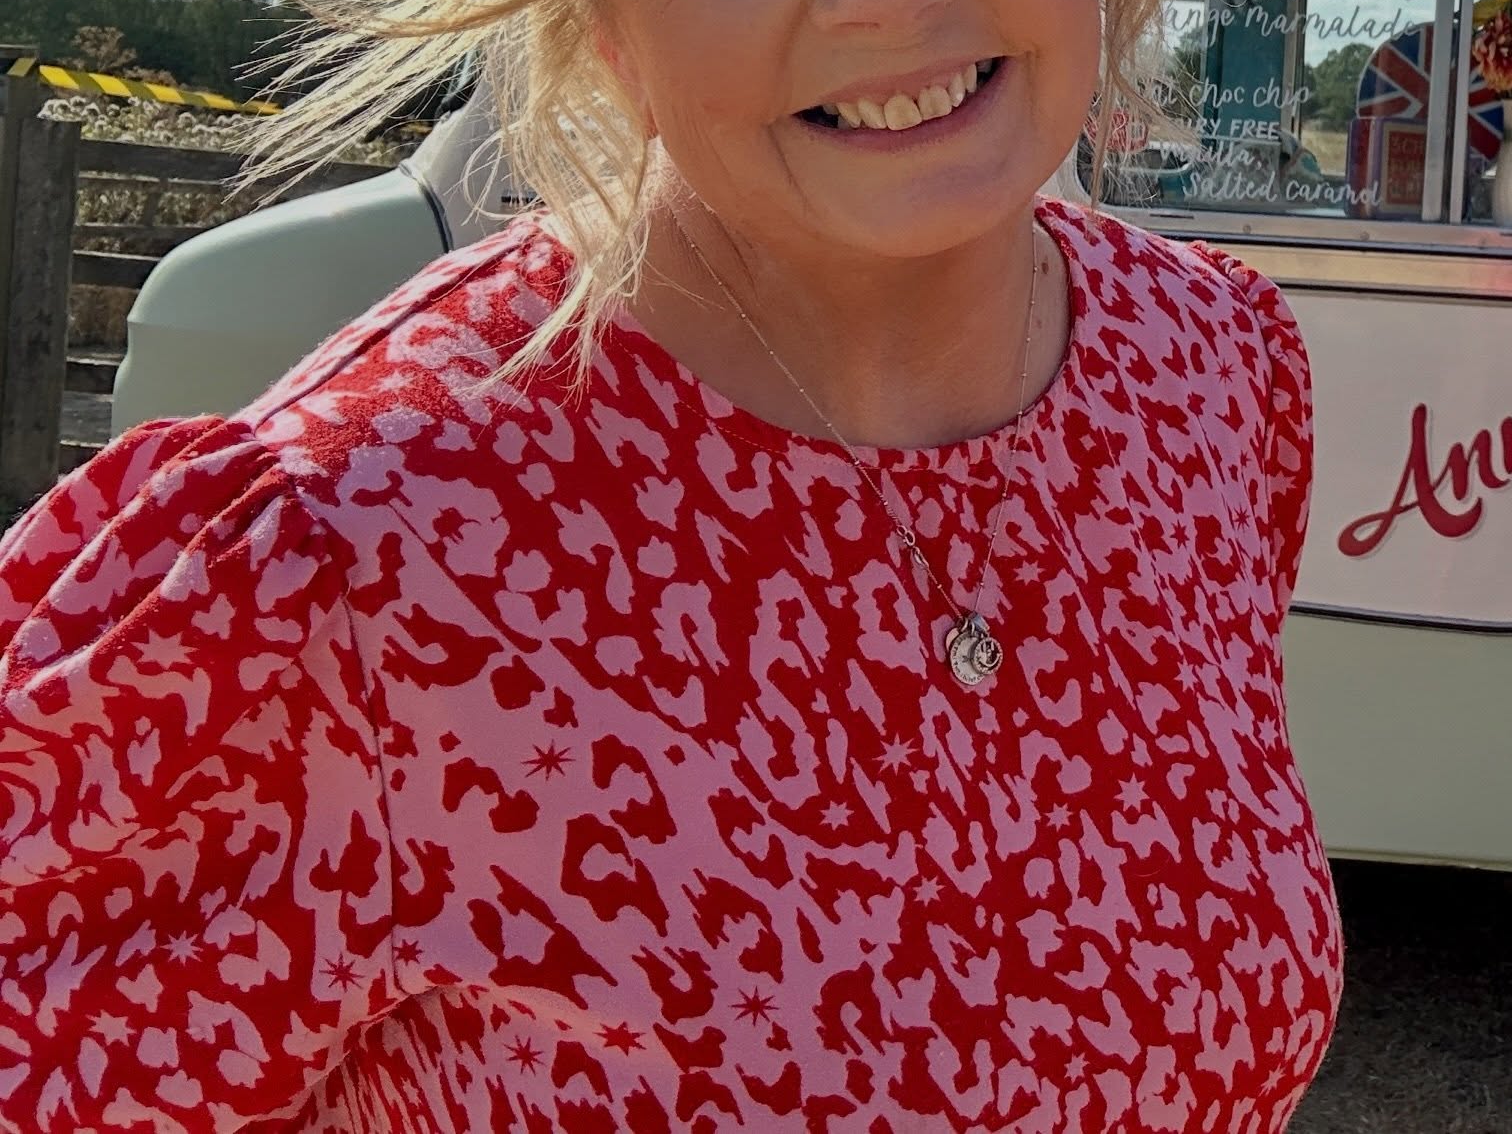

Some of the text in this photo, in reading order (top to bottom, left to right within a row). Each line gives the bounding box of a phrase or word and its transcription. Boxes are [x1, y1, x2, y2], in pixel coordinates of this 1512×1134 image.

[1244, 4, 1426, 40] marmalade
[1188, 76, 1245, 109] choc
[1252, 76, 1312, 120] chip
[1230, 118, 1280, 140] FREE
[1182, 170, 1279, 204] Salted
